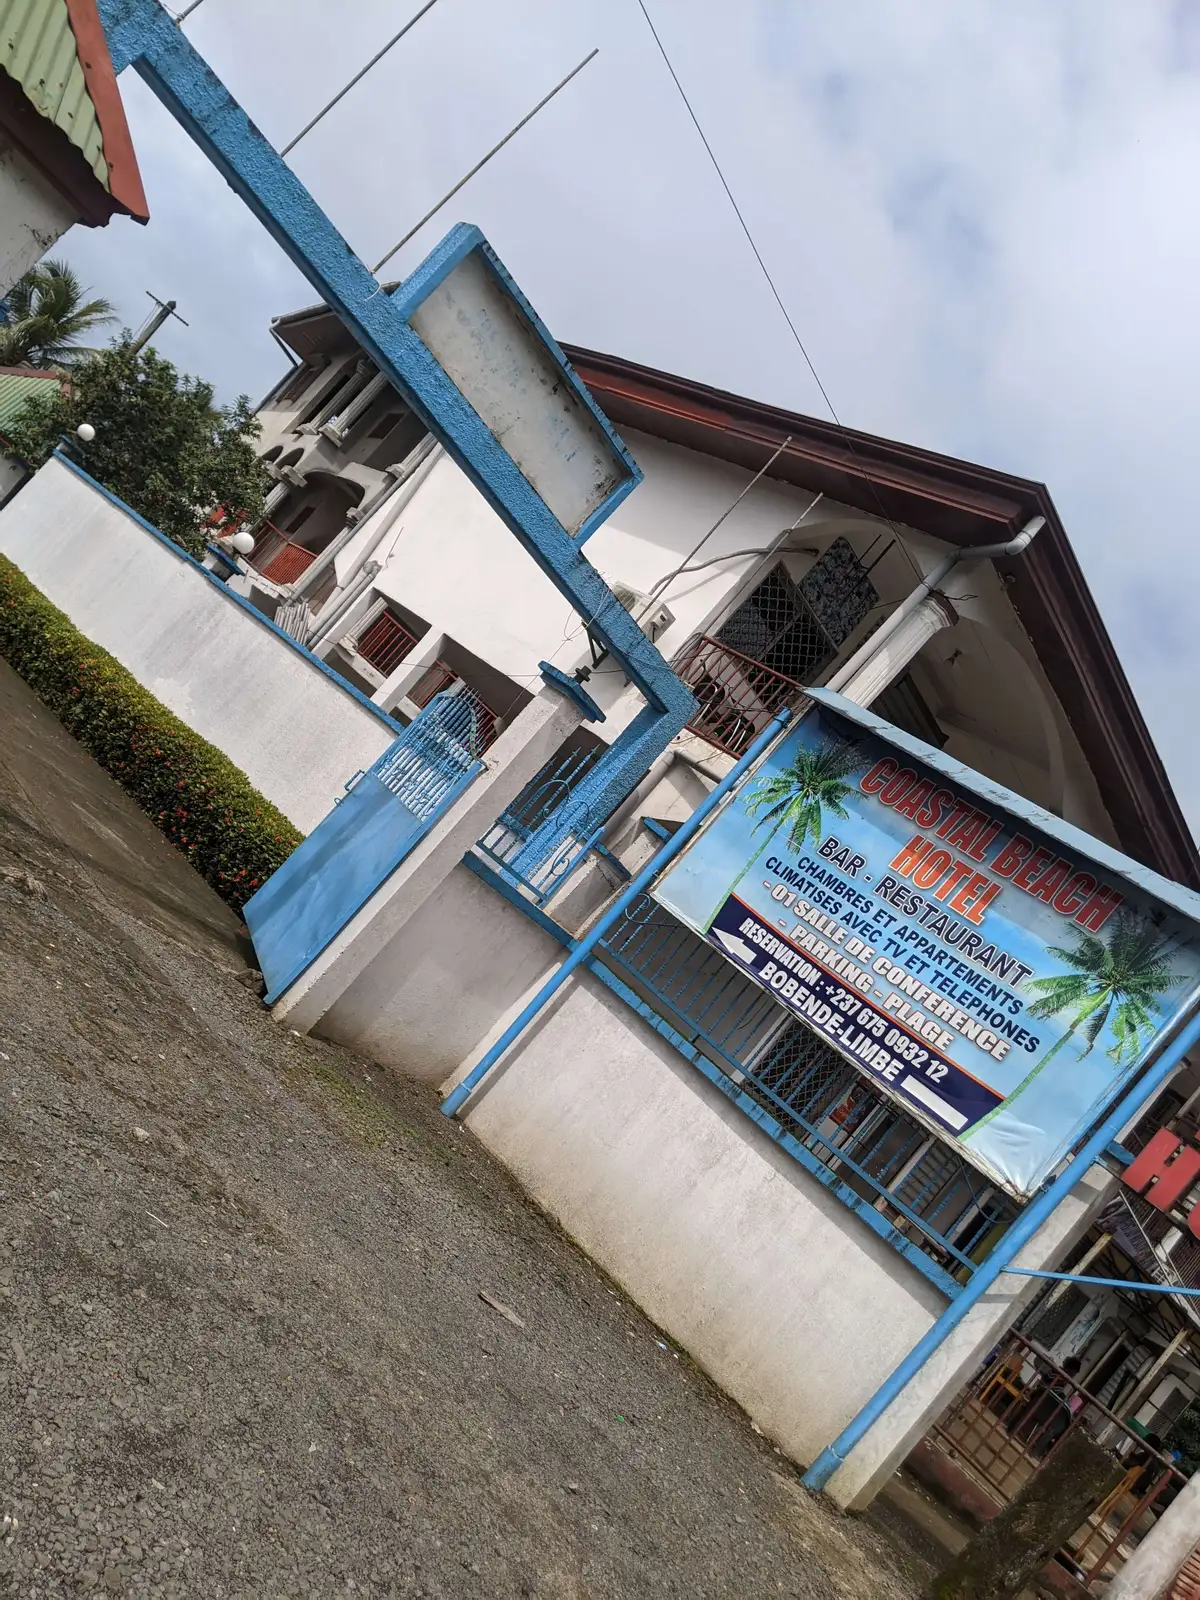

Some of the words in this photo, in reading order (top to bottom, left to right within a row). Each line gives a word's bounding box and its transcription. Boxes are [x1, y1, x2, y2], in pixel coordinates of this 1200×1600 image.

[817, 836, 866, 878] BAR
[873, 875, 1035, 987] RESTAURANT
[860, 757, 1004, 862] COASTAL
[988, 832, 1124, 933] BEACH
[888, 834, 1002, 926] HOTEL
[738, 917, 822, 987] RESERVATION
[825, 985, 862, 1015] +237
[856, 1007, 888, 1037] 675
[925, 1059, 949, 1084] 12
[765, 856, 842, 915] CLIMATISES
[840, 912, 882, 943] AVEC
[883, 938, 907, 959] TV
[904, 955, 930, 974] ET
[929, 970, 1040, 1053] TELEPHONES
[770, 883, 797, 907] 01
[793, 899, 849, 945] SALLE
[844, 936, 876, 964] DE
[872, 956, 1012, 1061] CONFERENCE
[789, 924, 875, 994] PARKING
[882, 991, 955, 1051] PLAGE
[797, 856, 873, 914] CHAMBRES
[872, 908, 897, 928] ET
[894, 925, 1024, 1015] APPARTEMENTS
[758, 961, 904, 1082] BOBENDE-LIMBE
